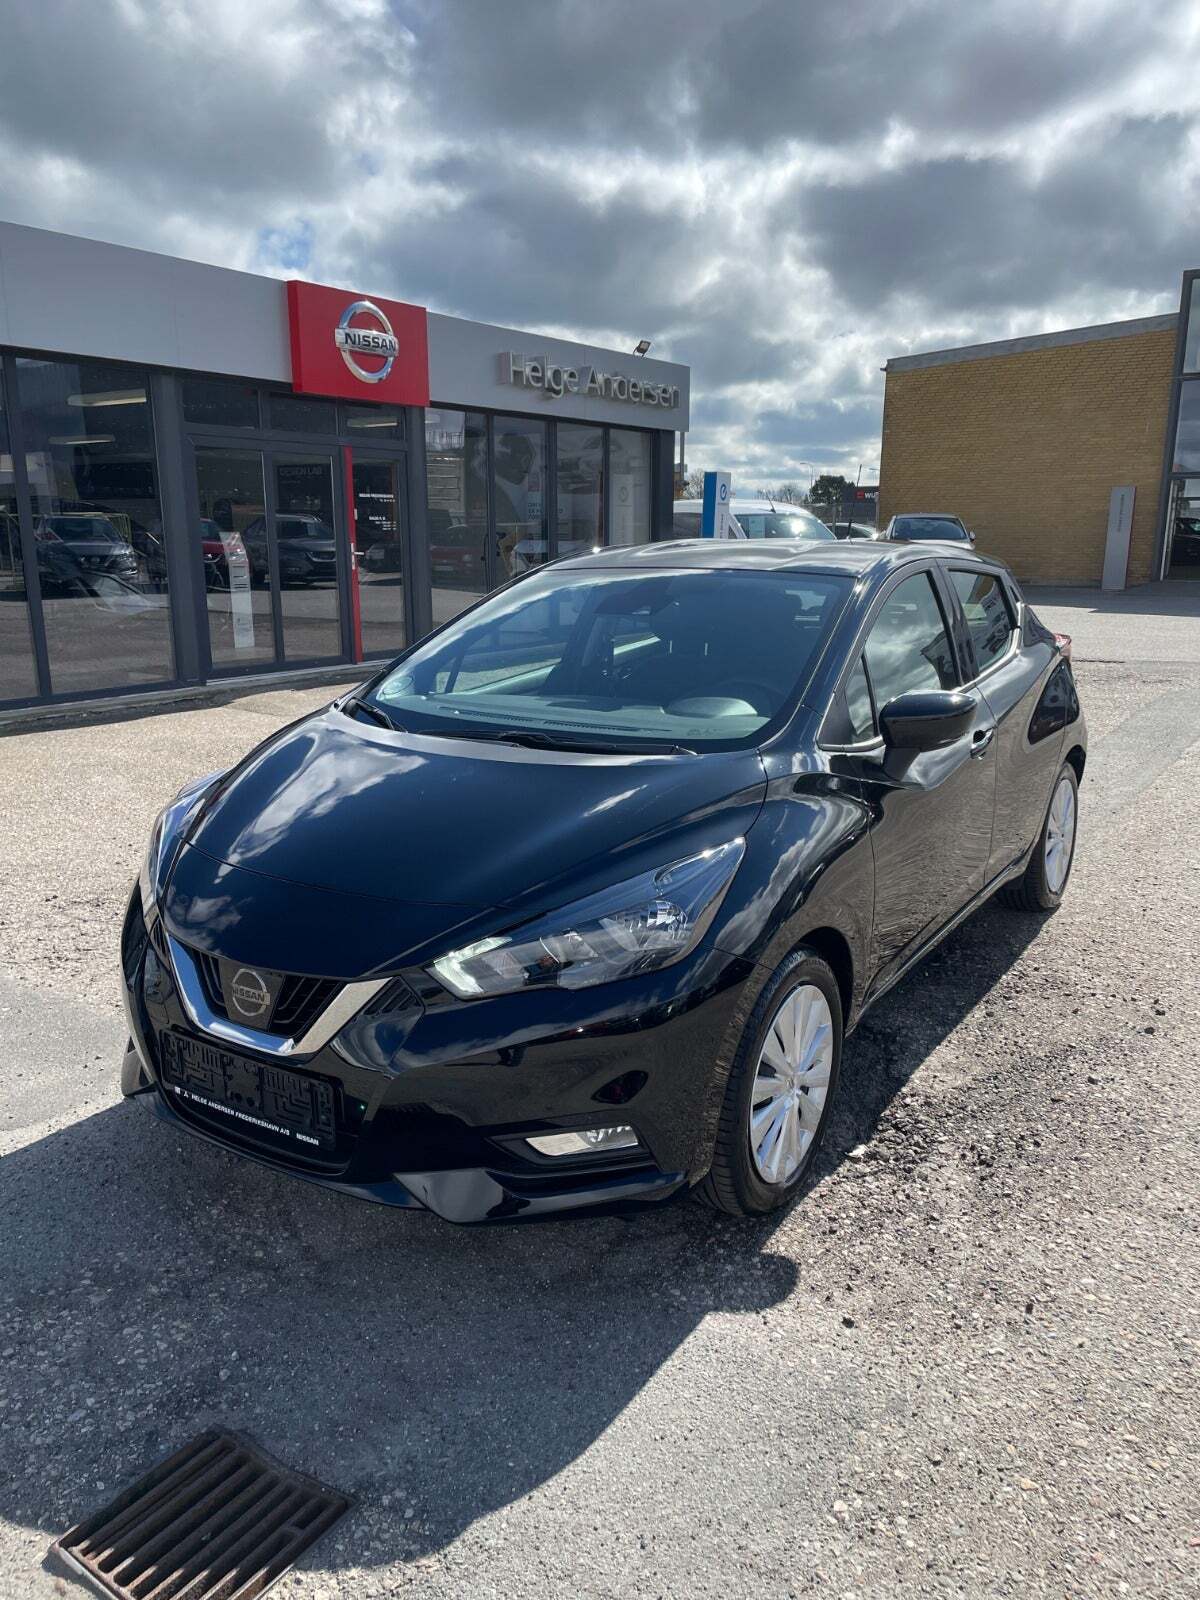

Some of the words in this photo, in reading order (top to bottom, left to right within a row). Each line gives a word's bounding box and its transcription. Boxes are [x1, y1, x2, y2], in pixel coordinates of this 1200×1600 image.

[344, 332, 396, 352] NISSAN
[508, 350, 580, 399] Helge
[585, 366, 681, 408] Andersen
[232, 986, 265, 1003] NISSAN
[191, 1093, 207, 1105] HELGE
[207, 1100, 235, 1116] ANDERSEN
[235, 1111, 280, 1132] FREDERIKSHAVN
[280, 1127, 290, 1136] A/S
[296, 1132, 319, 1146] NISSAN
